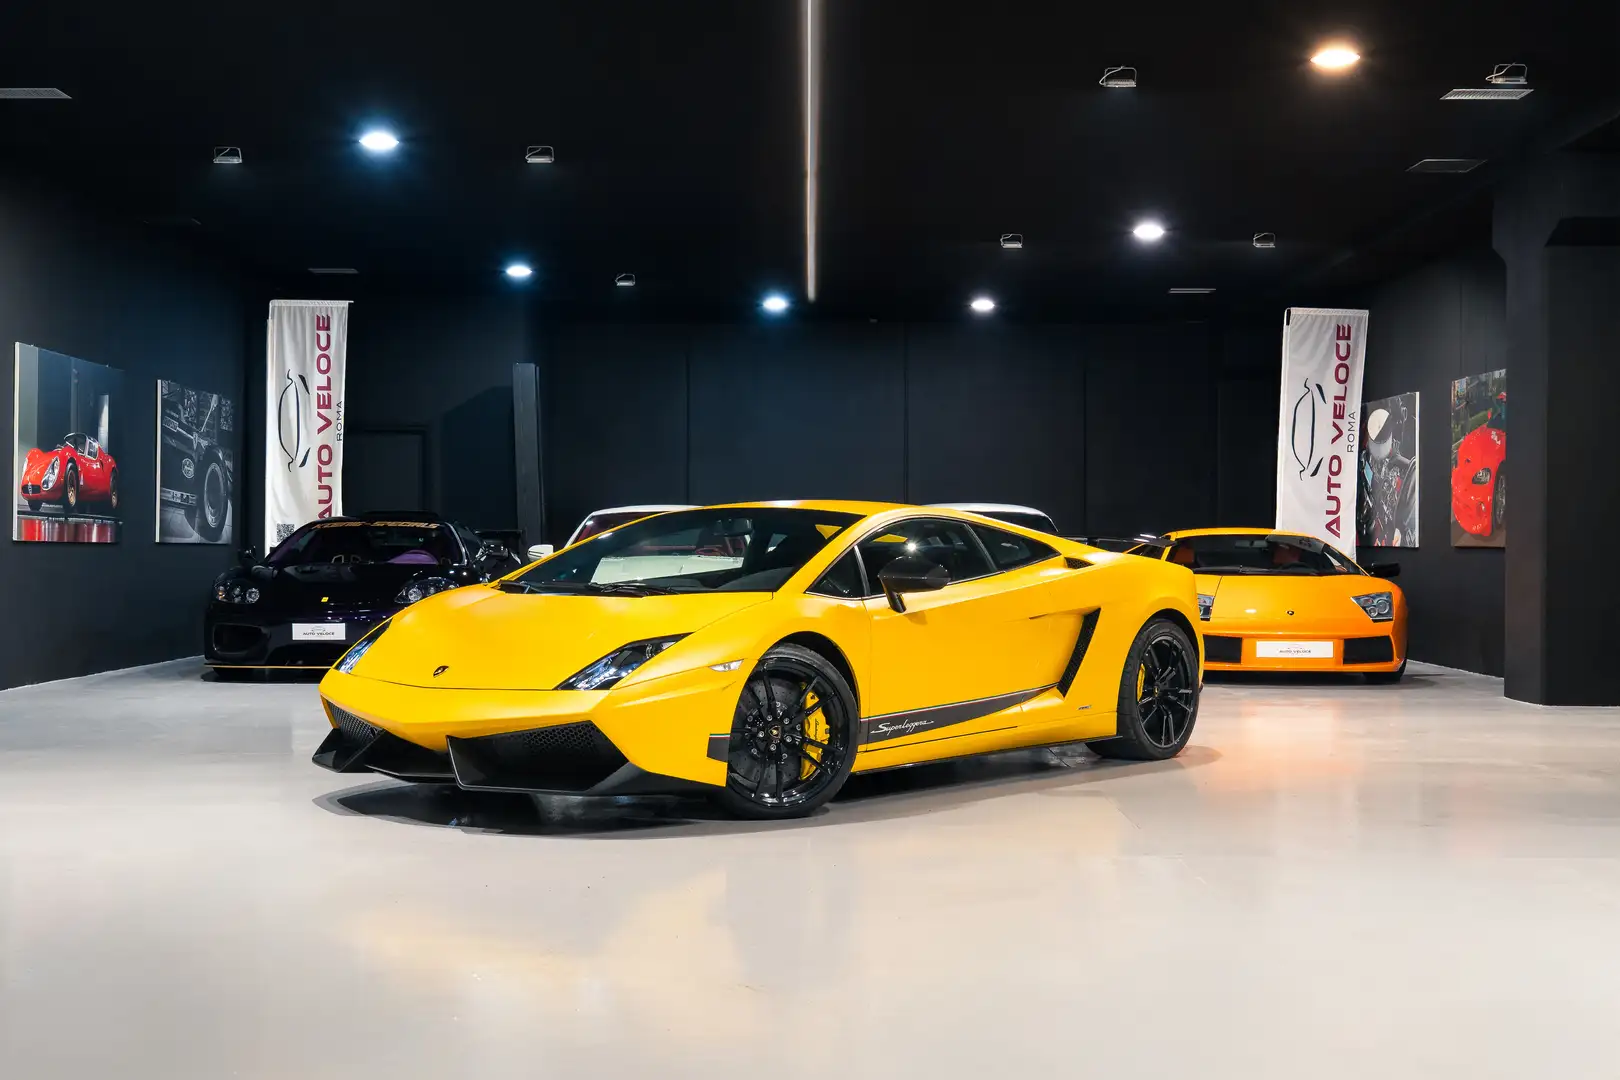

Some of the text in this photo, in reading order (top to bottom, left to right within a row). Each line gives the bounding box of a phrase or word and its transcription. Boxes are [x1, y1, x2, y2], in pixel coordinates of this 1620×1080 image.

[316, 314, 333, 520] AUTO VELOCE
[1325, 323, 1352, 539] AUTO VELOCE
[1347, 411, 1356, 453] ROMA
[870, 718, 935, 737] Superleggera
